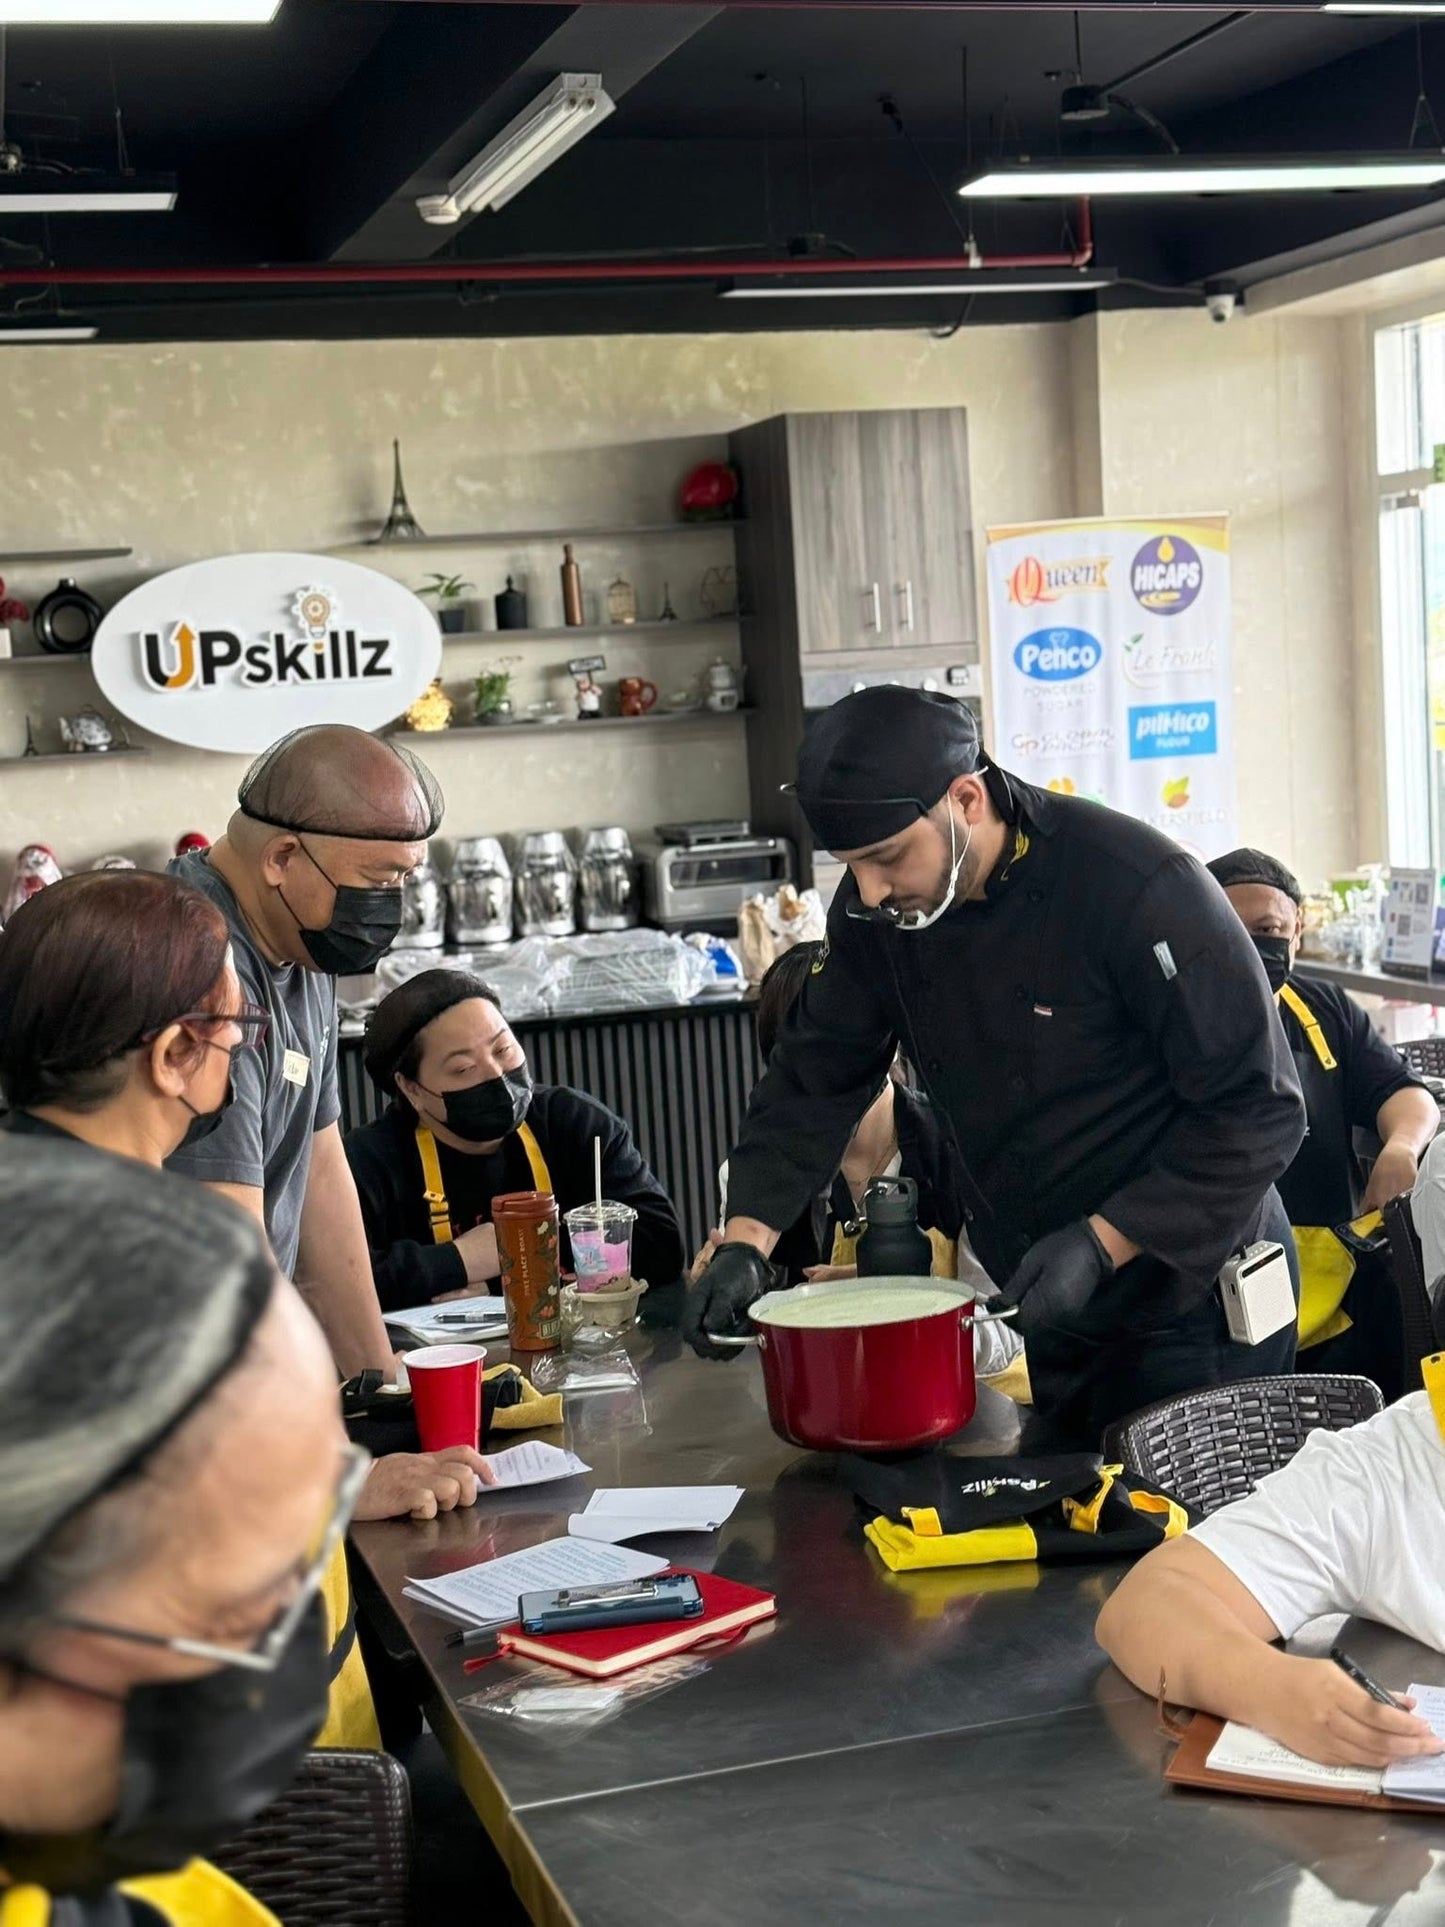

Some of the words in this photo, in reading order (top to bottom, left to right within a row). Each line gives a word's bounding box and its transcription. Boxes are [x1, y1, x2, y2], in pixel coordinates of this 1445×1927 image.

[1012, 555, 1098, 607] Queen
[1134, 561, 1200, 591] HICAPS
[145, 622, 393, 688] UPskillz
[1022, 643, 1096, 673] Penco
